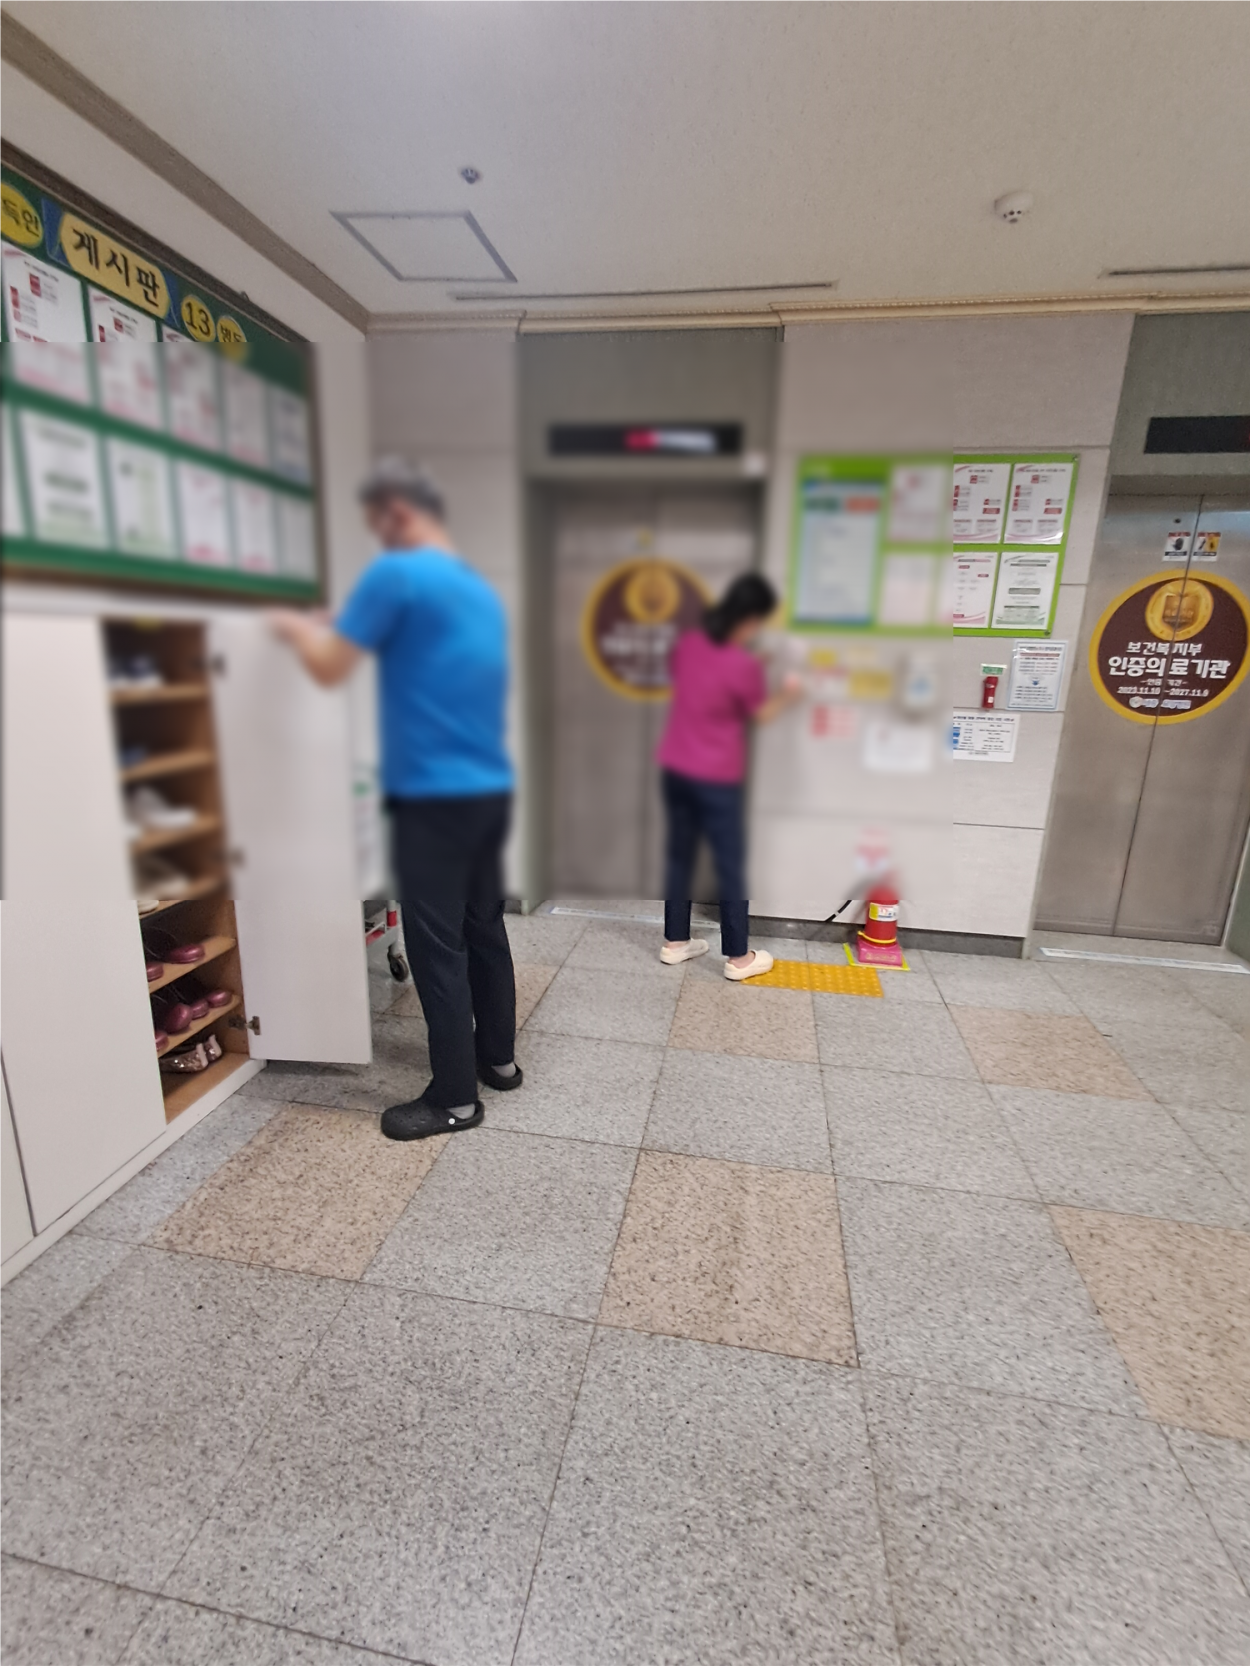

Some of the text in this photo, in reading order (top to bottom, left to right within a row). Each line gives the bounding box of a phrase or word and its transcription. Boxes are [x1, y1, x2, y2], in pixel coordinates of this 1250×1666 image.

[71, 227, 161, 308] 게시판
[185, 302, 211, 338] 13
[1126, 641, 1203, 656] 보건복지부
